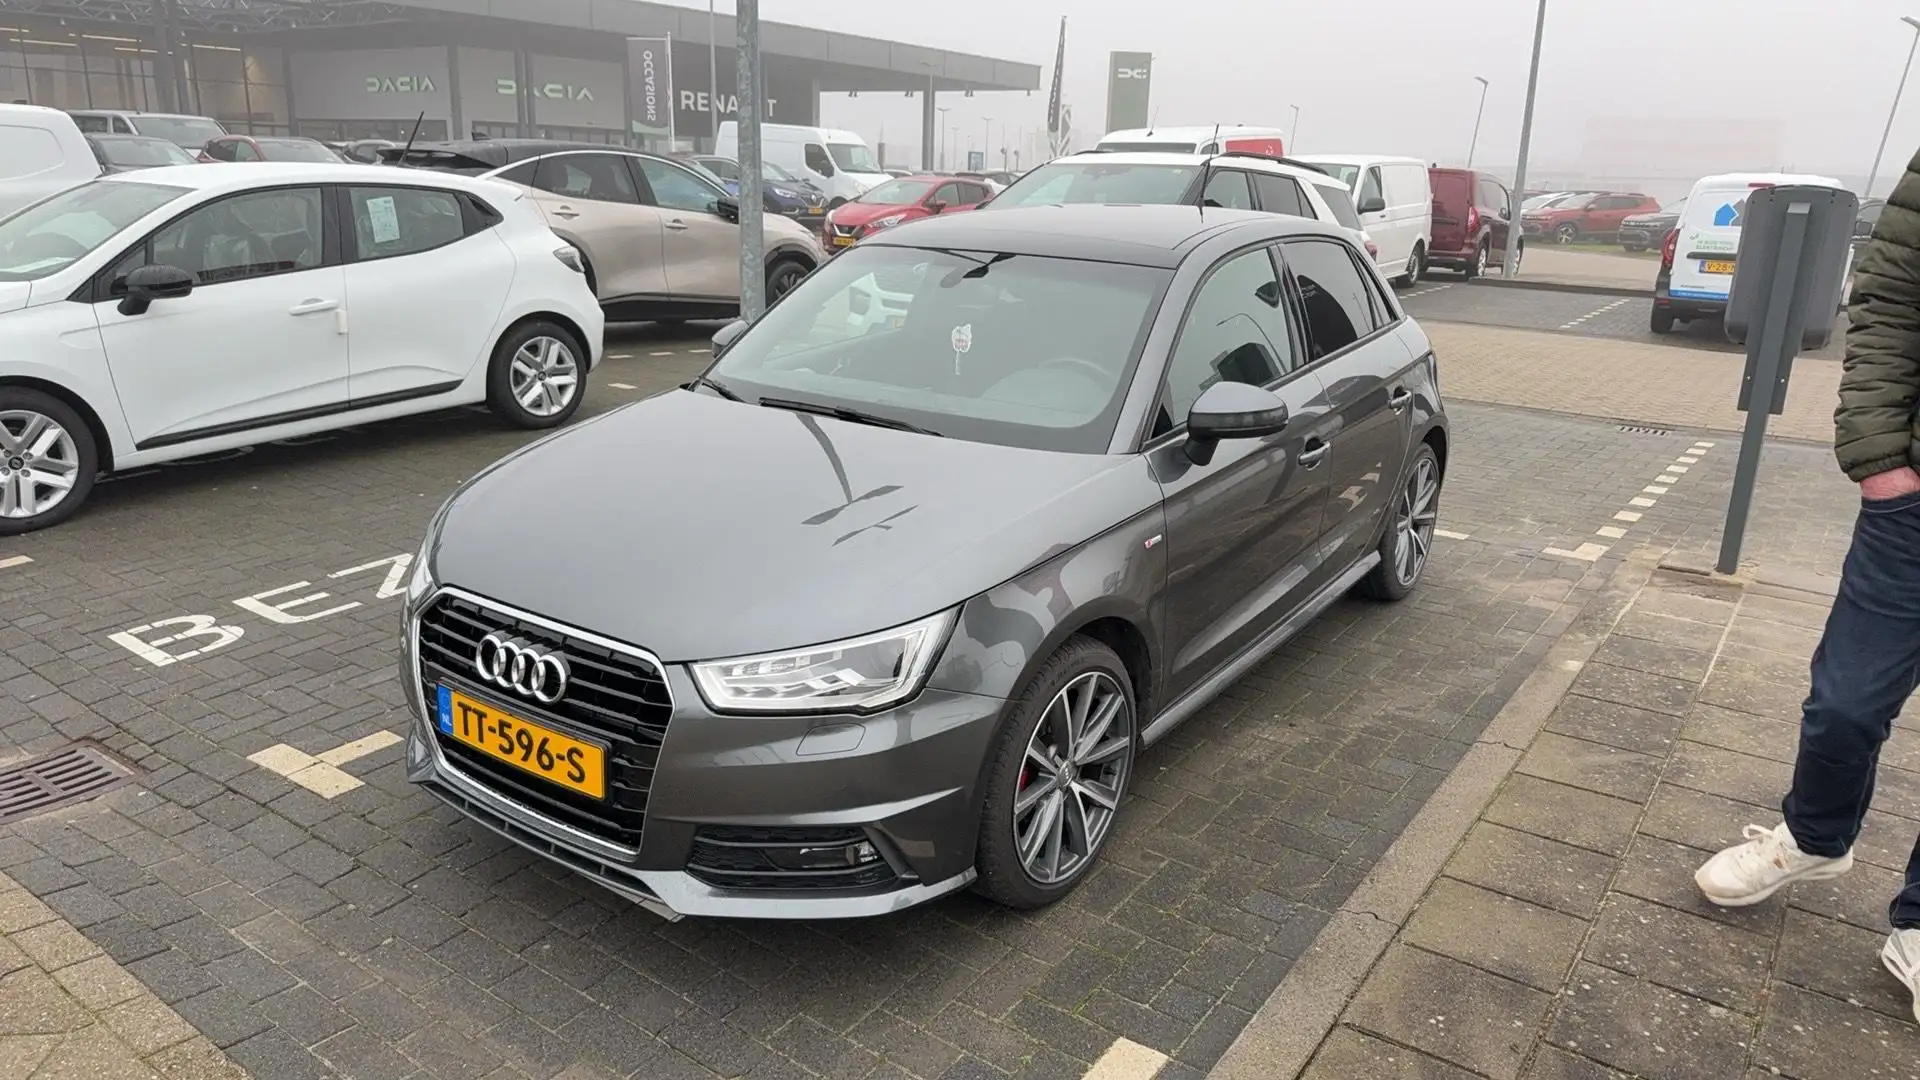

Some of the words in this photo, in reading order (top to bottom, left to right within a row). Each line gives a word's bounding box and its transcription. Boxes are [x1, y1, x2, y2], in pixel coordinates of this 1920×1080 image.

[365, 77, 436, 93] DACIA
[680, 90, 778, 118] RENAT
[441, 712, 453, 727] NL
[456, 700, 587, 784] TT-596-S
